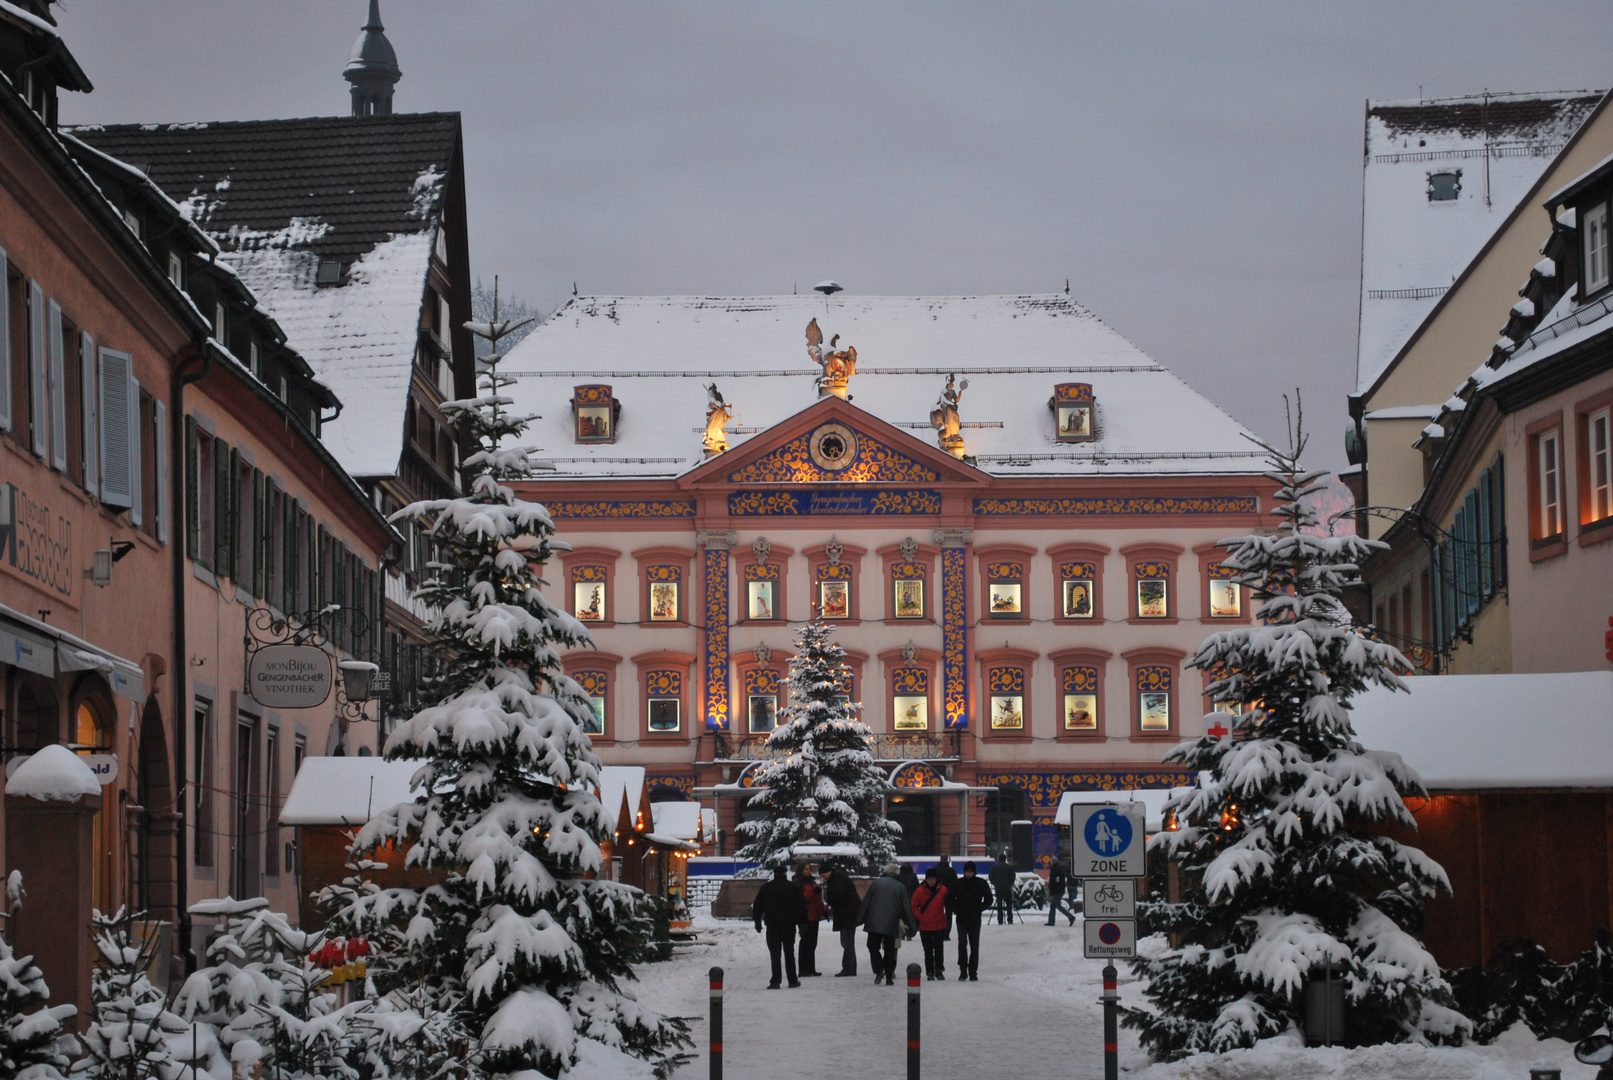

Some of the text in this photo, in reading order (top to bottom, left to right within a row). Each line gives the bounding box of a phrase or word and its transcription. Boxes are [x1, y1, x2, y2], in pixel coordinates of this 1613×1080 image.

[811, 492, 863, 506] Gengenbacher
[802, 503, 868, 514] Adventskalender
[258, 672, 323, 682] GENGENBACHER
[265, 684, 315, 693] VINOTHEK
[1091, 860, 1127, 872] ZONE
[1101, 904, 1118, 913] frei
[1088, 945, 1132, 955] Rettungsweg
